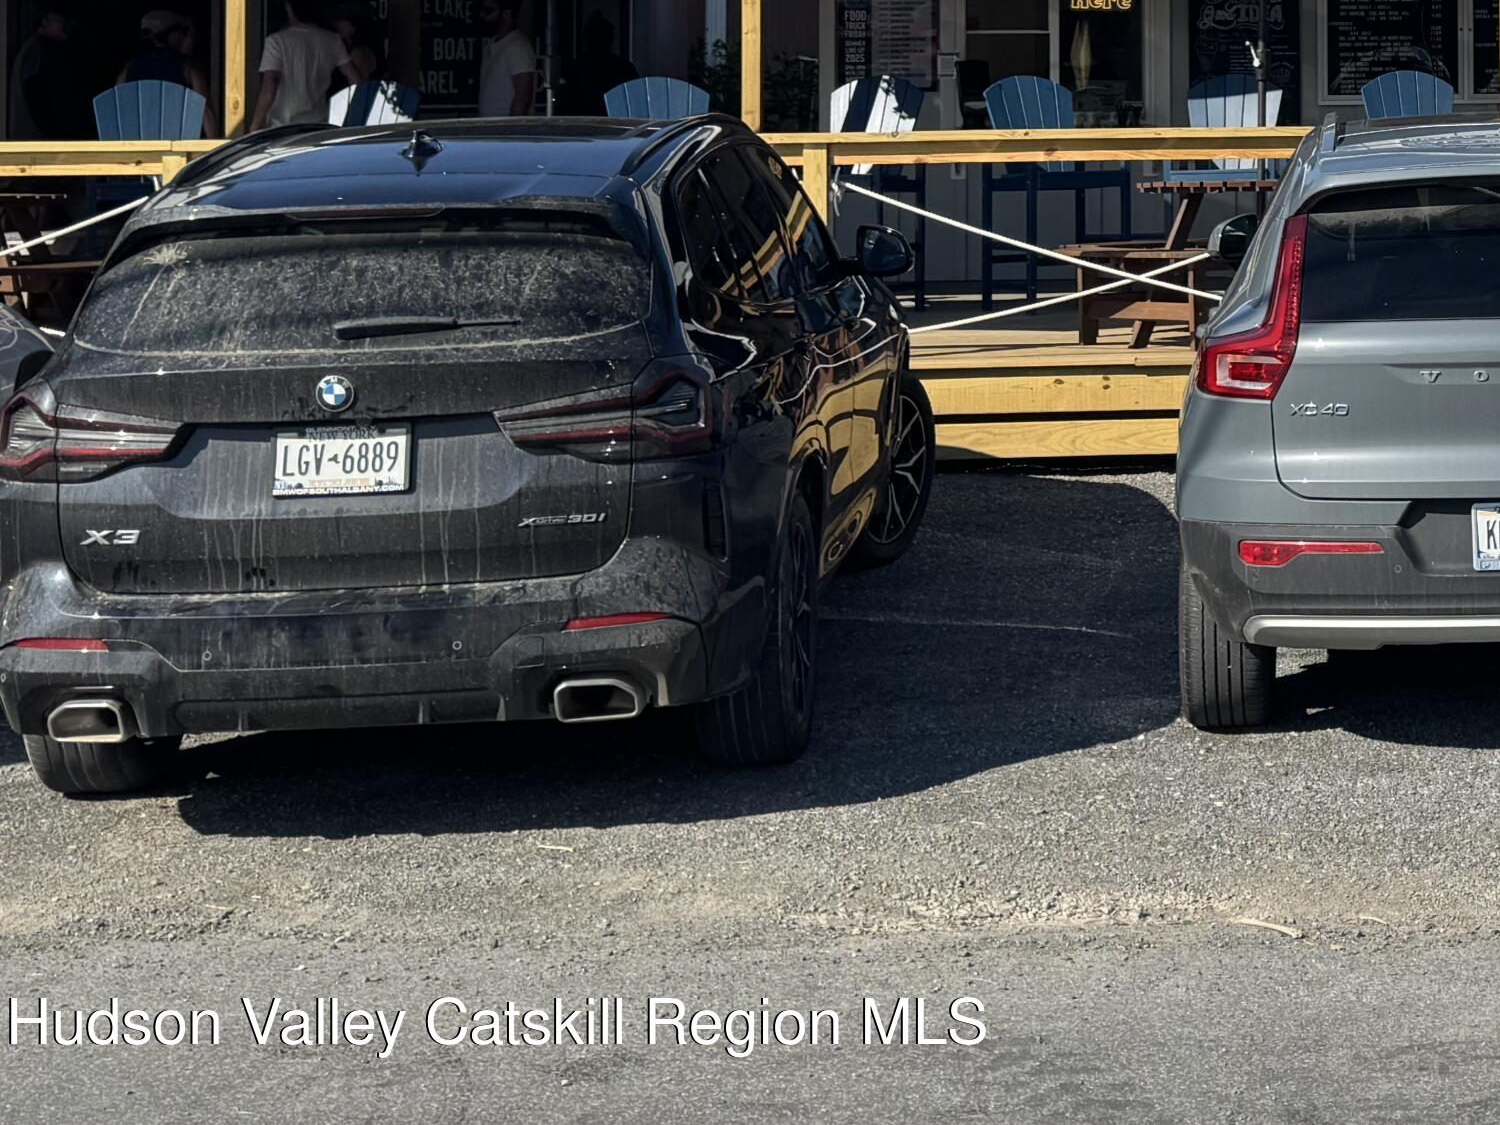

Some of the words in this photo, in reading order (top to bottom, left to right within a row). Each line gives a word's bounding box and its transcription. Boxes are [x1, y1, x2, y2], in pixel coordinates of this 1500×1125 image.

[843, 10, 867, 21] FOOD
[433, 37, 477, 61] BOAT
[308, 431, 338, 442] NEW
[342, 430, 377, 441] YORK
[282, 444, 326, 477] LGV
[342, 440, 399, 474] 6889
[79, 528, 141, 546] X3
